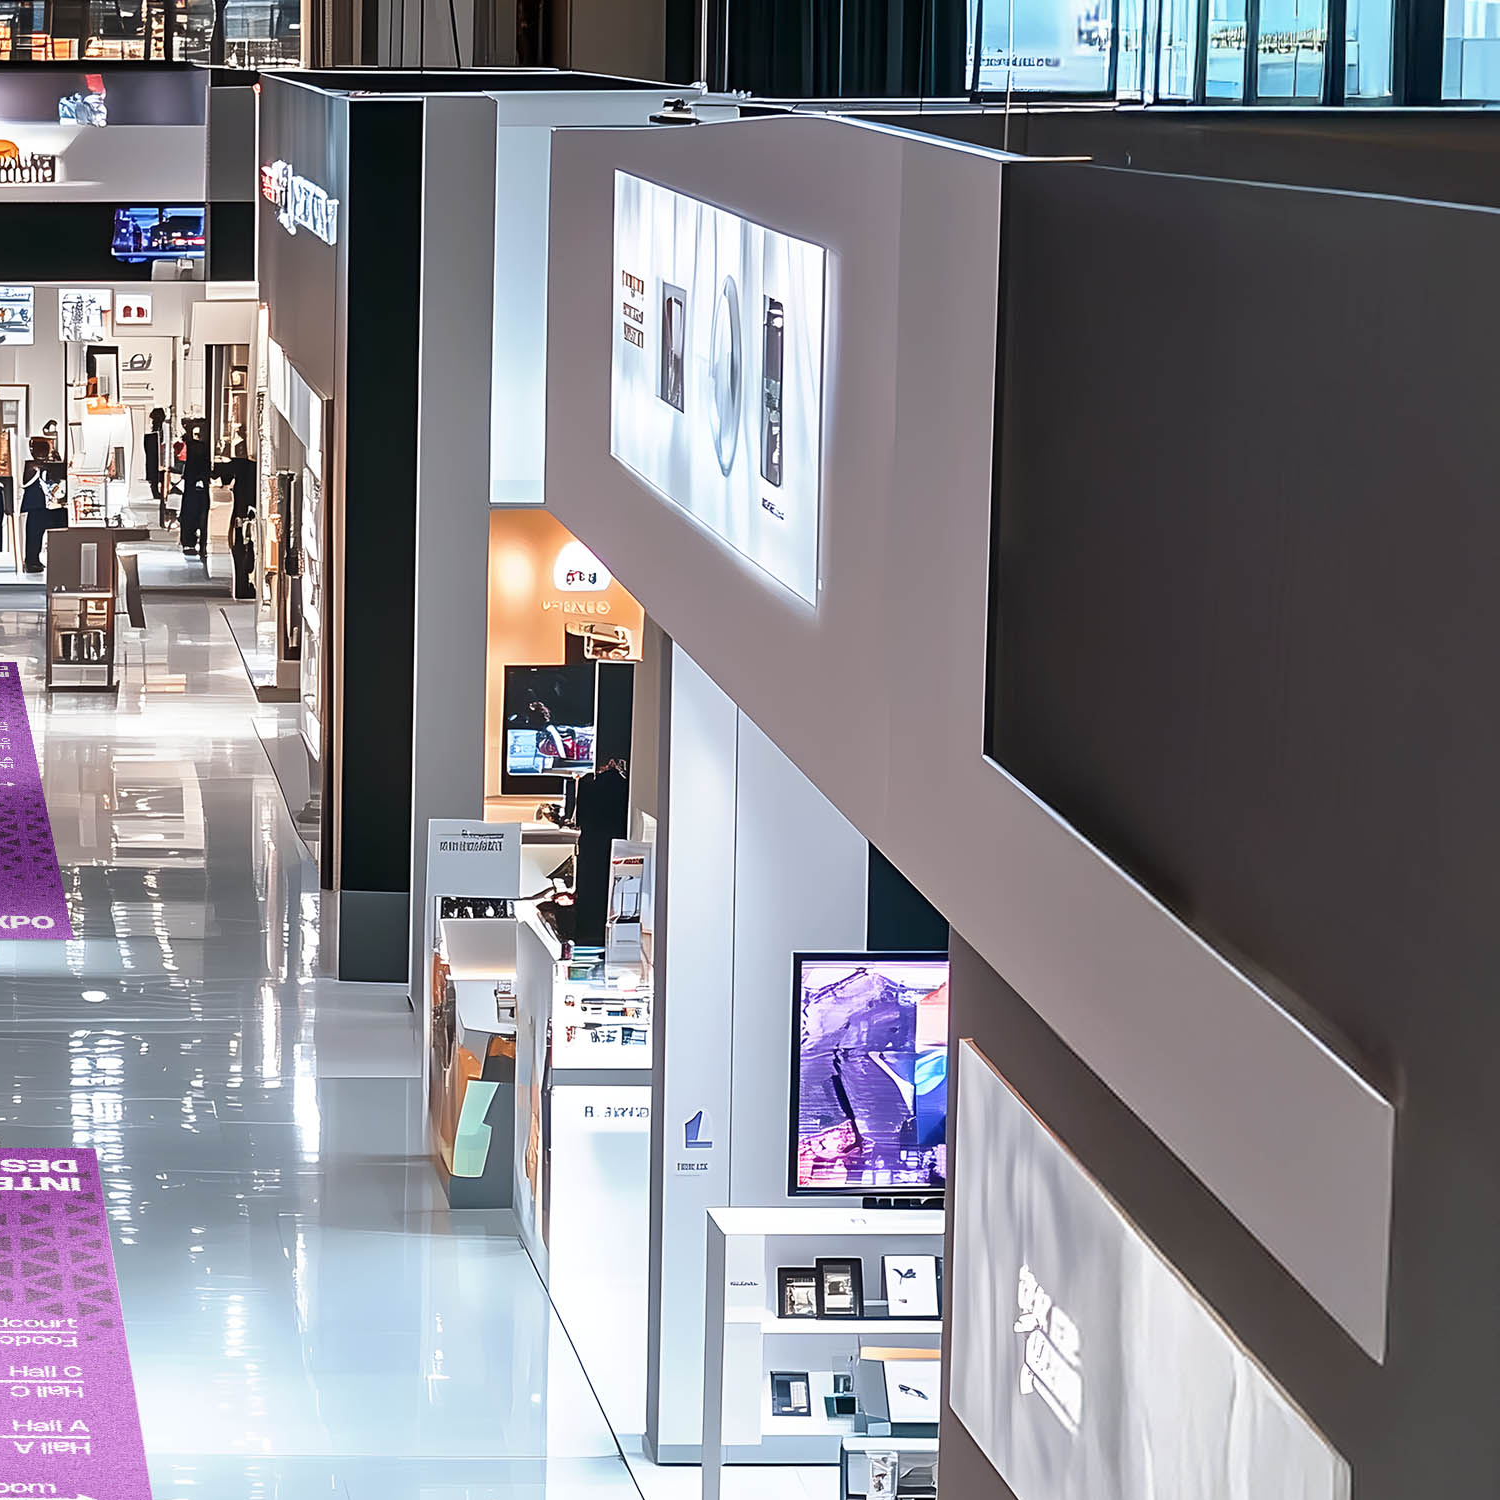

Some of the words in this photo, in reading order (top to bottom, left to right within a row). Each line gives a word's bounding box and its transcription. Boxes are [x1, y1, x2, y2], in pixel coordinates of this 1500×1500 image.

[9, 1365, 59, 1378] Hall
[64, 1365, 83, 1378] C
[9, 1385, 31, 1398] C
[36, 1385, 84, 1398] Hall
[12, 1419, 63, 1433] Hall
[69, 1419, 90, 1433] A
[13, 1440, 35, 1455] A
[40, 1440, 91, 1455] Hall
